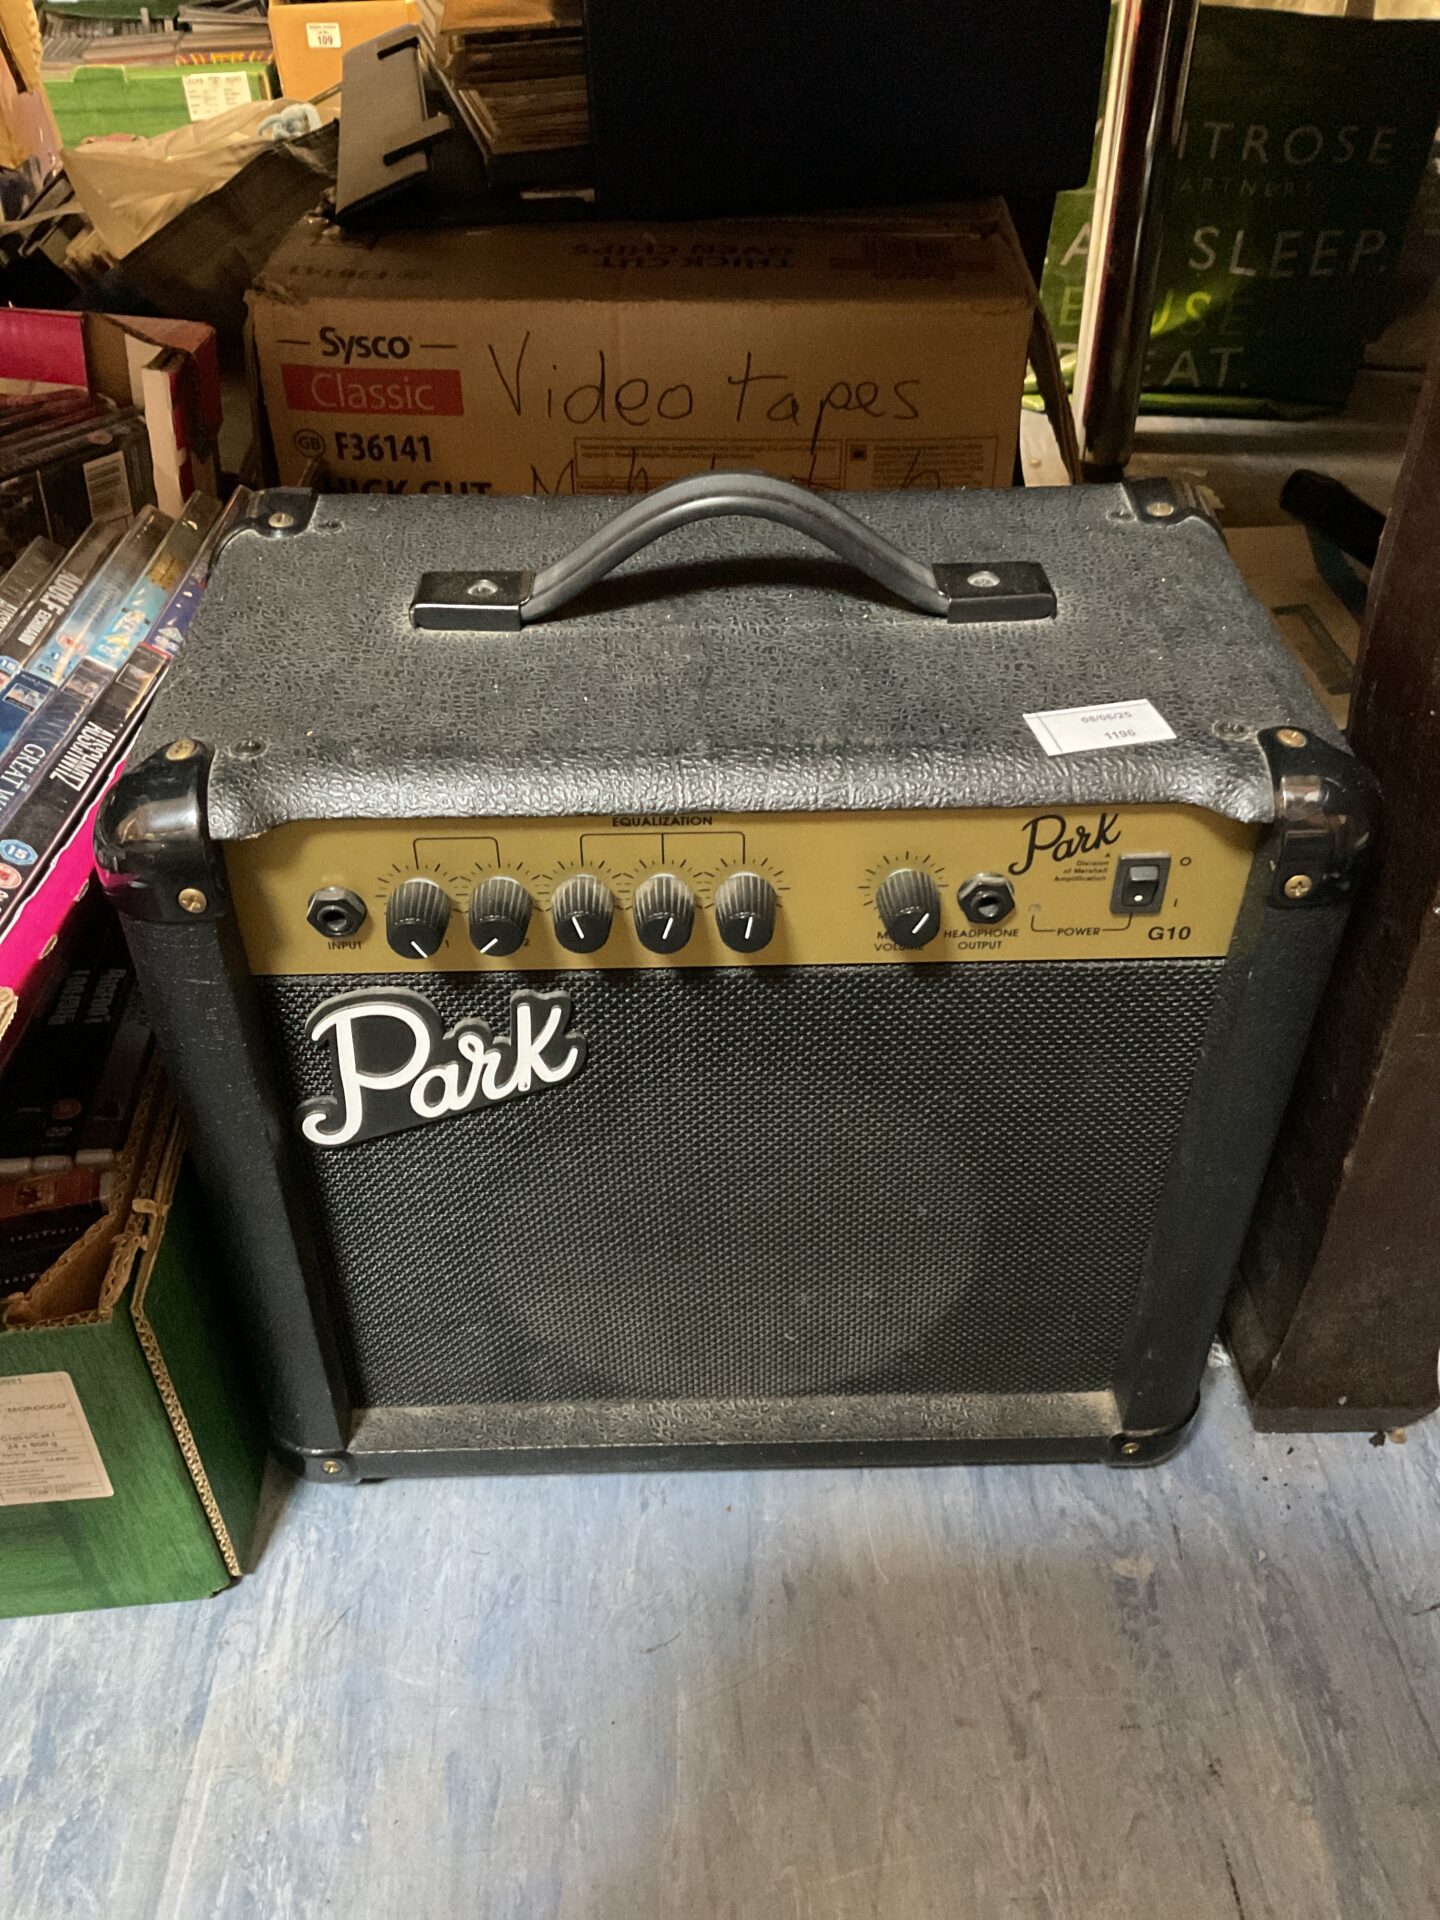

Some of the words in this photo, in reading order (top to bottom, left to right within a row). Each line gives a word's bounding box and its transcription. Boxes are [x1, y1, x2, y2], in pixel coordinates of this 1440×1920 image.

[318, 35, 333, 45] 109
[1176, 119, 1399, 166] ITROSE
[319, 326, 411, 365] Sysco
[310, 372, 435, 411] Classic
[488, 331, 693, 427] Video
[727, 351, 921, 455] tapes
[299, 437, 321, 451] GB
[334, 431, 433, 463] F36141
[40, 569, 84, 616] ADOLF
[0, 743, 47, 790] GREAT
[49, 721, 116, 793] AUSCHWITZ
[612, 815, 714, 828] EQUALIZATION
[8, 844, 29, 857] 15
[1007, 812, 1123, 876] Park
[327, 940, 364, 952] INPUT
[944, 928, 1020, 940] HEADPHONE
[957, 940, 1003, 951] OUTPUT
[1056, 927, 1101, 937] POWER
[1147, 926, 1192, 941] G10
[302, 1001, 579, 1147] Park
